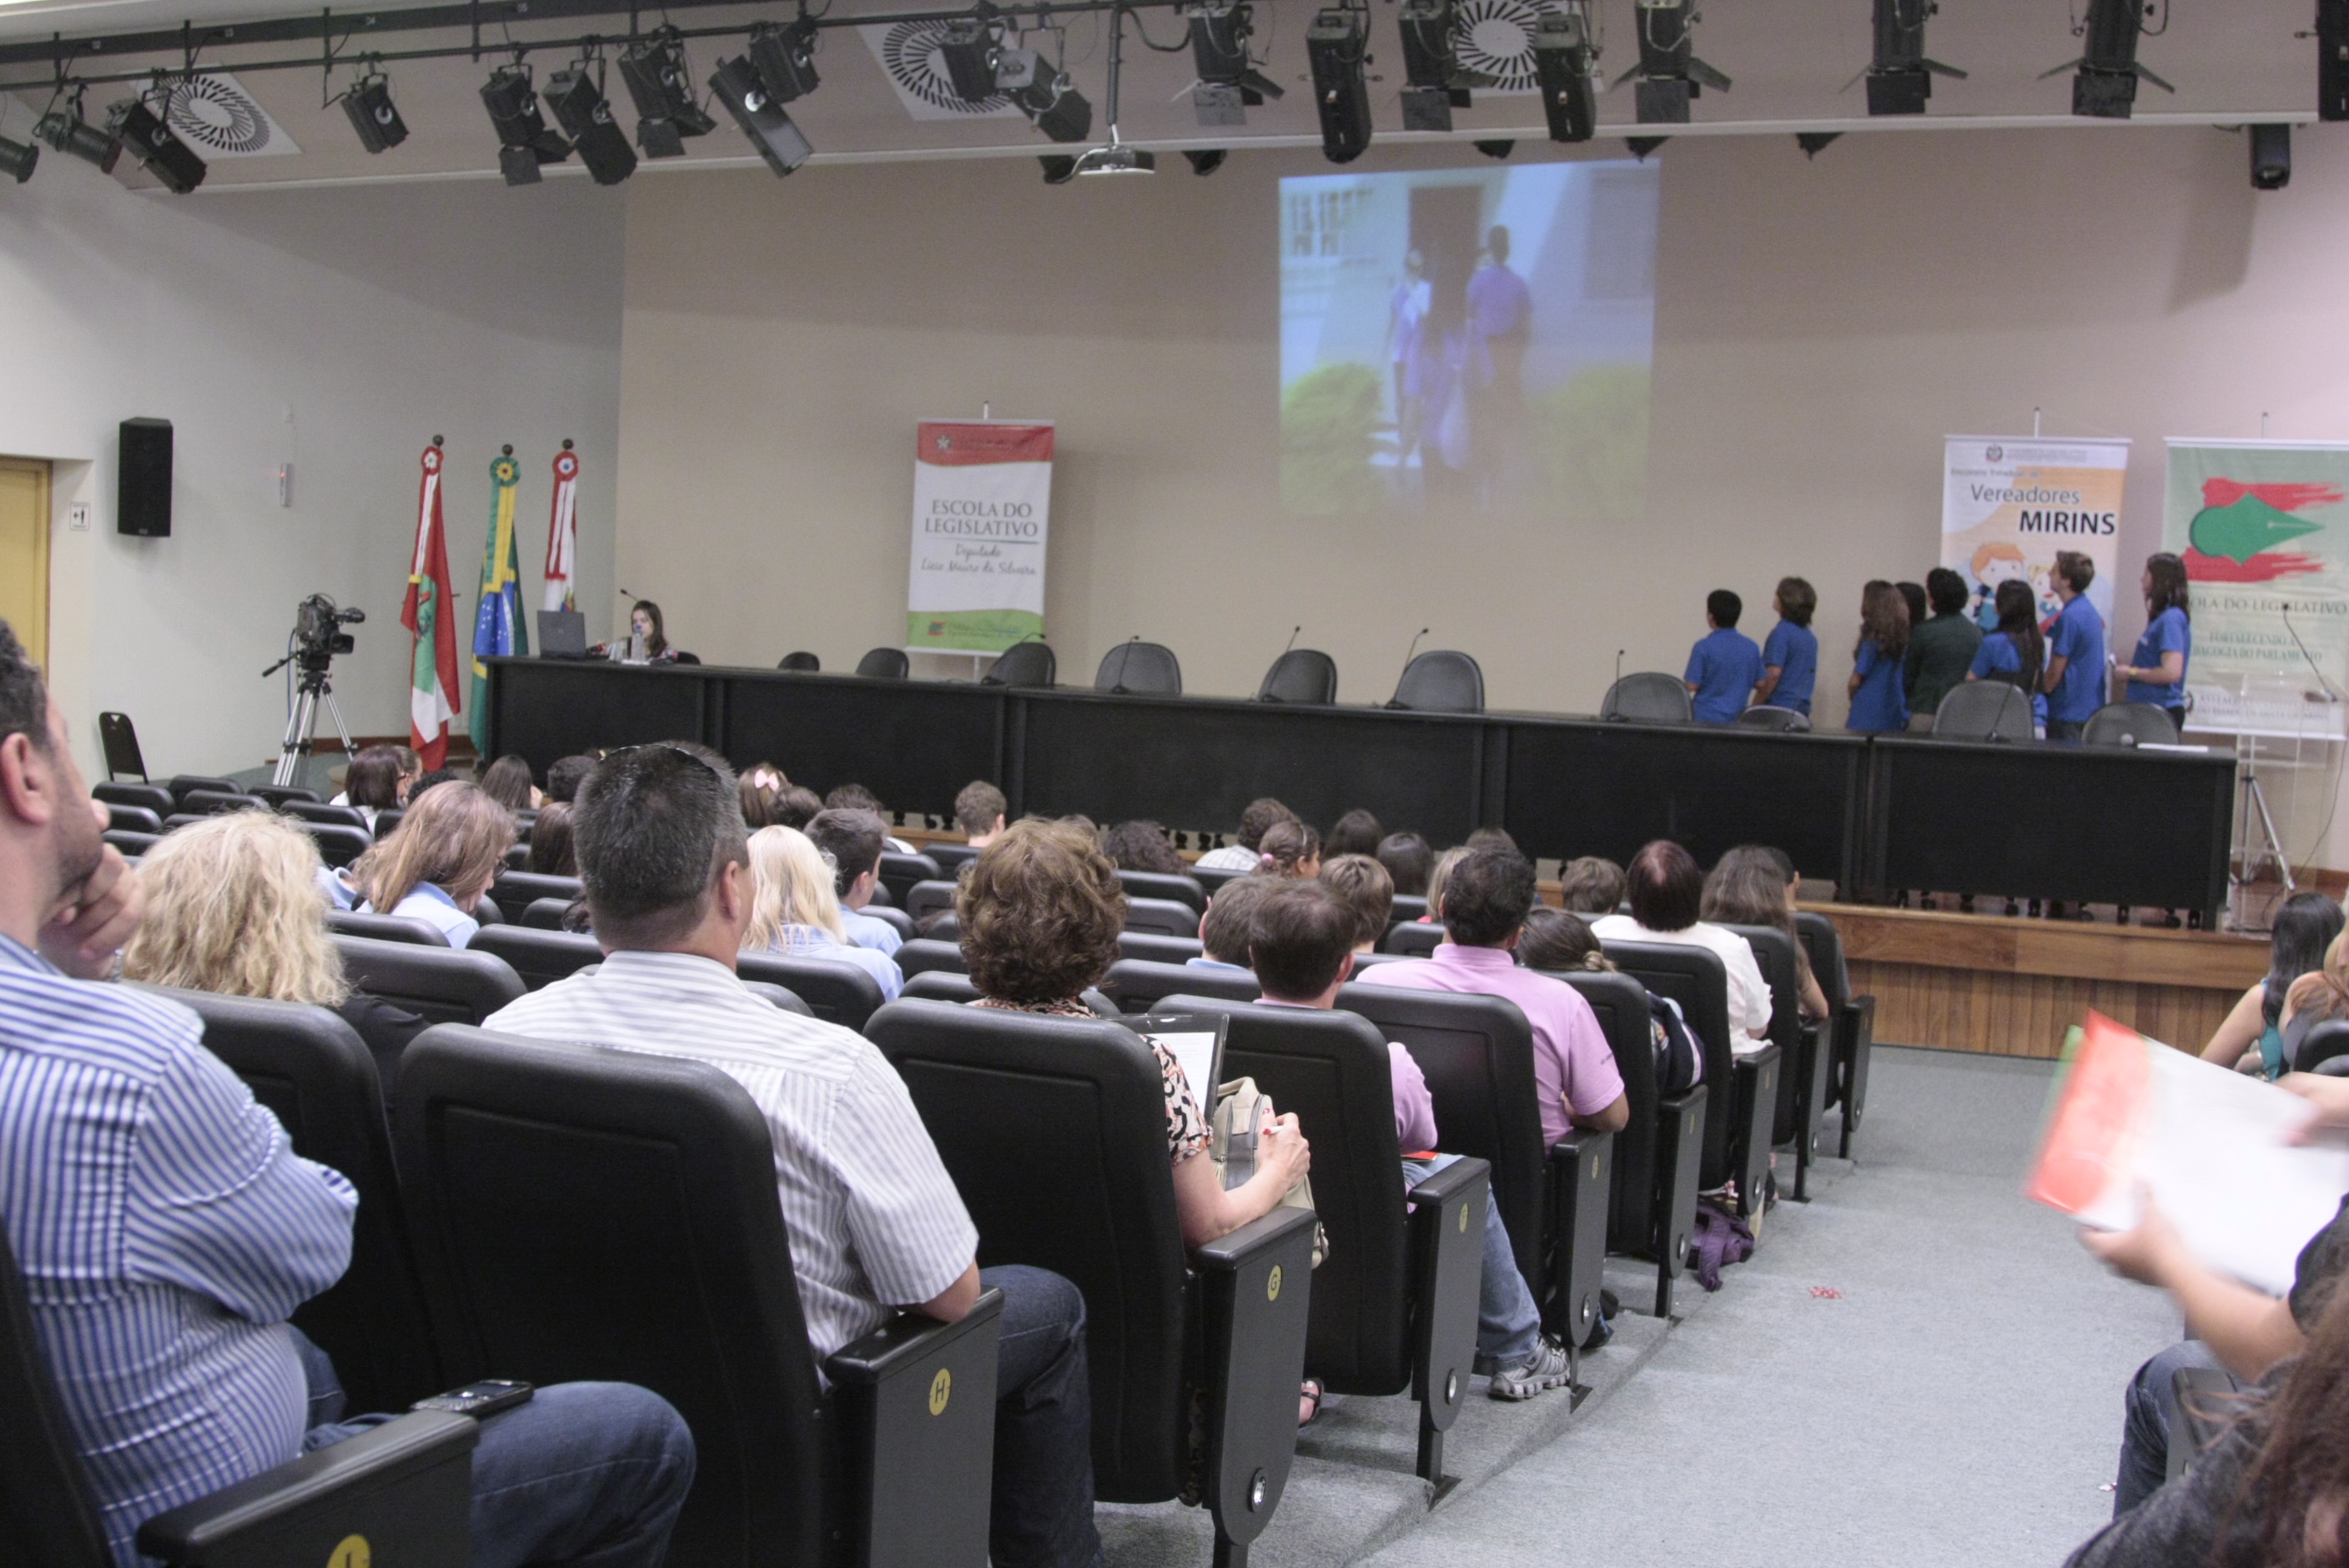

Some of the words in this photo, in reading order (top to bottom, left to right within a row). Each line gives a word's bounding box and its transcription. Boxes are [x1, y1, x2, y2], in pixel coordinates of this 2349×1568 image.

[1970, 483, 2080, 505] Vereadores
[932, 499, 998, 516] ESCOLA
[1003, 501, 1033, 518] DO
[925, 517, 1039, 536] LEGISLATIVO
[2019, 510, 2116, 535] MIRINS
[955, 543, 1002, 562] Deputado
[982, 560, 994, 573] da
[998, 560, 1036, 575] Silveira
[2224, 597, 2248, 611] DO
[2252, 599, 2347, 616] LEGLATIVO
[2256, 648, 2323, 662] PARLAMETO
[1270, 1274, 1278, 1291] G
[934, 1378, 946, 1404] H
